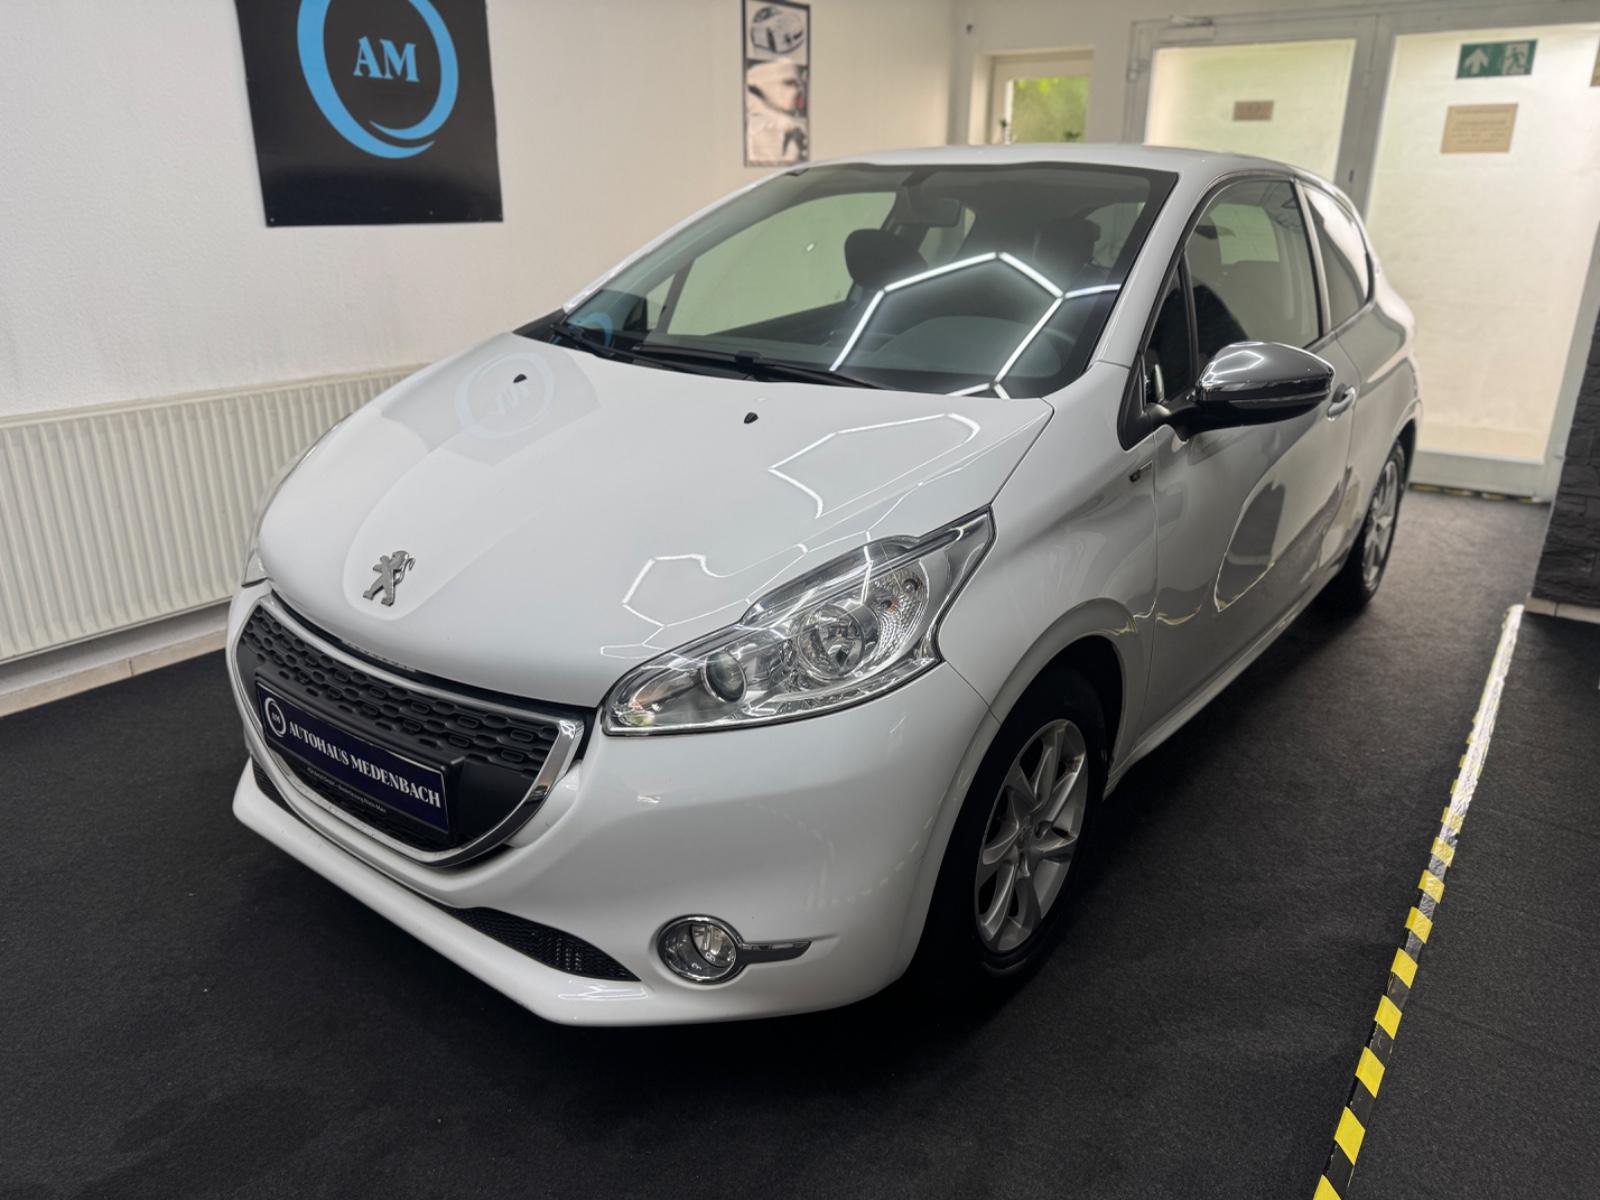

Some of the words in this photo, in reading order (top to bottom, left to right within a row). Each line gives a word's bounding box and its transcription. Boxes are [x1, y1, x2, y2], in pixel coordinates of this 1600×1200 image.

[353, 36, 420, 82] AM
[289, 721, 350, 765] AUTOHAUS
[350, 754, 442, 809] MEDENBACH
